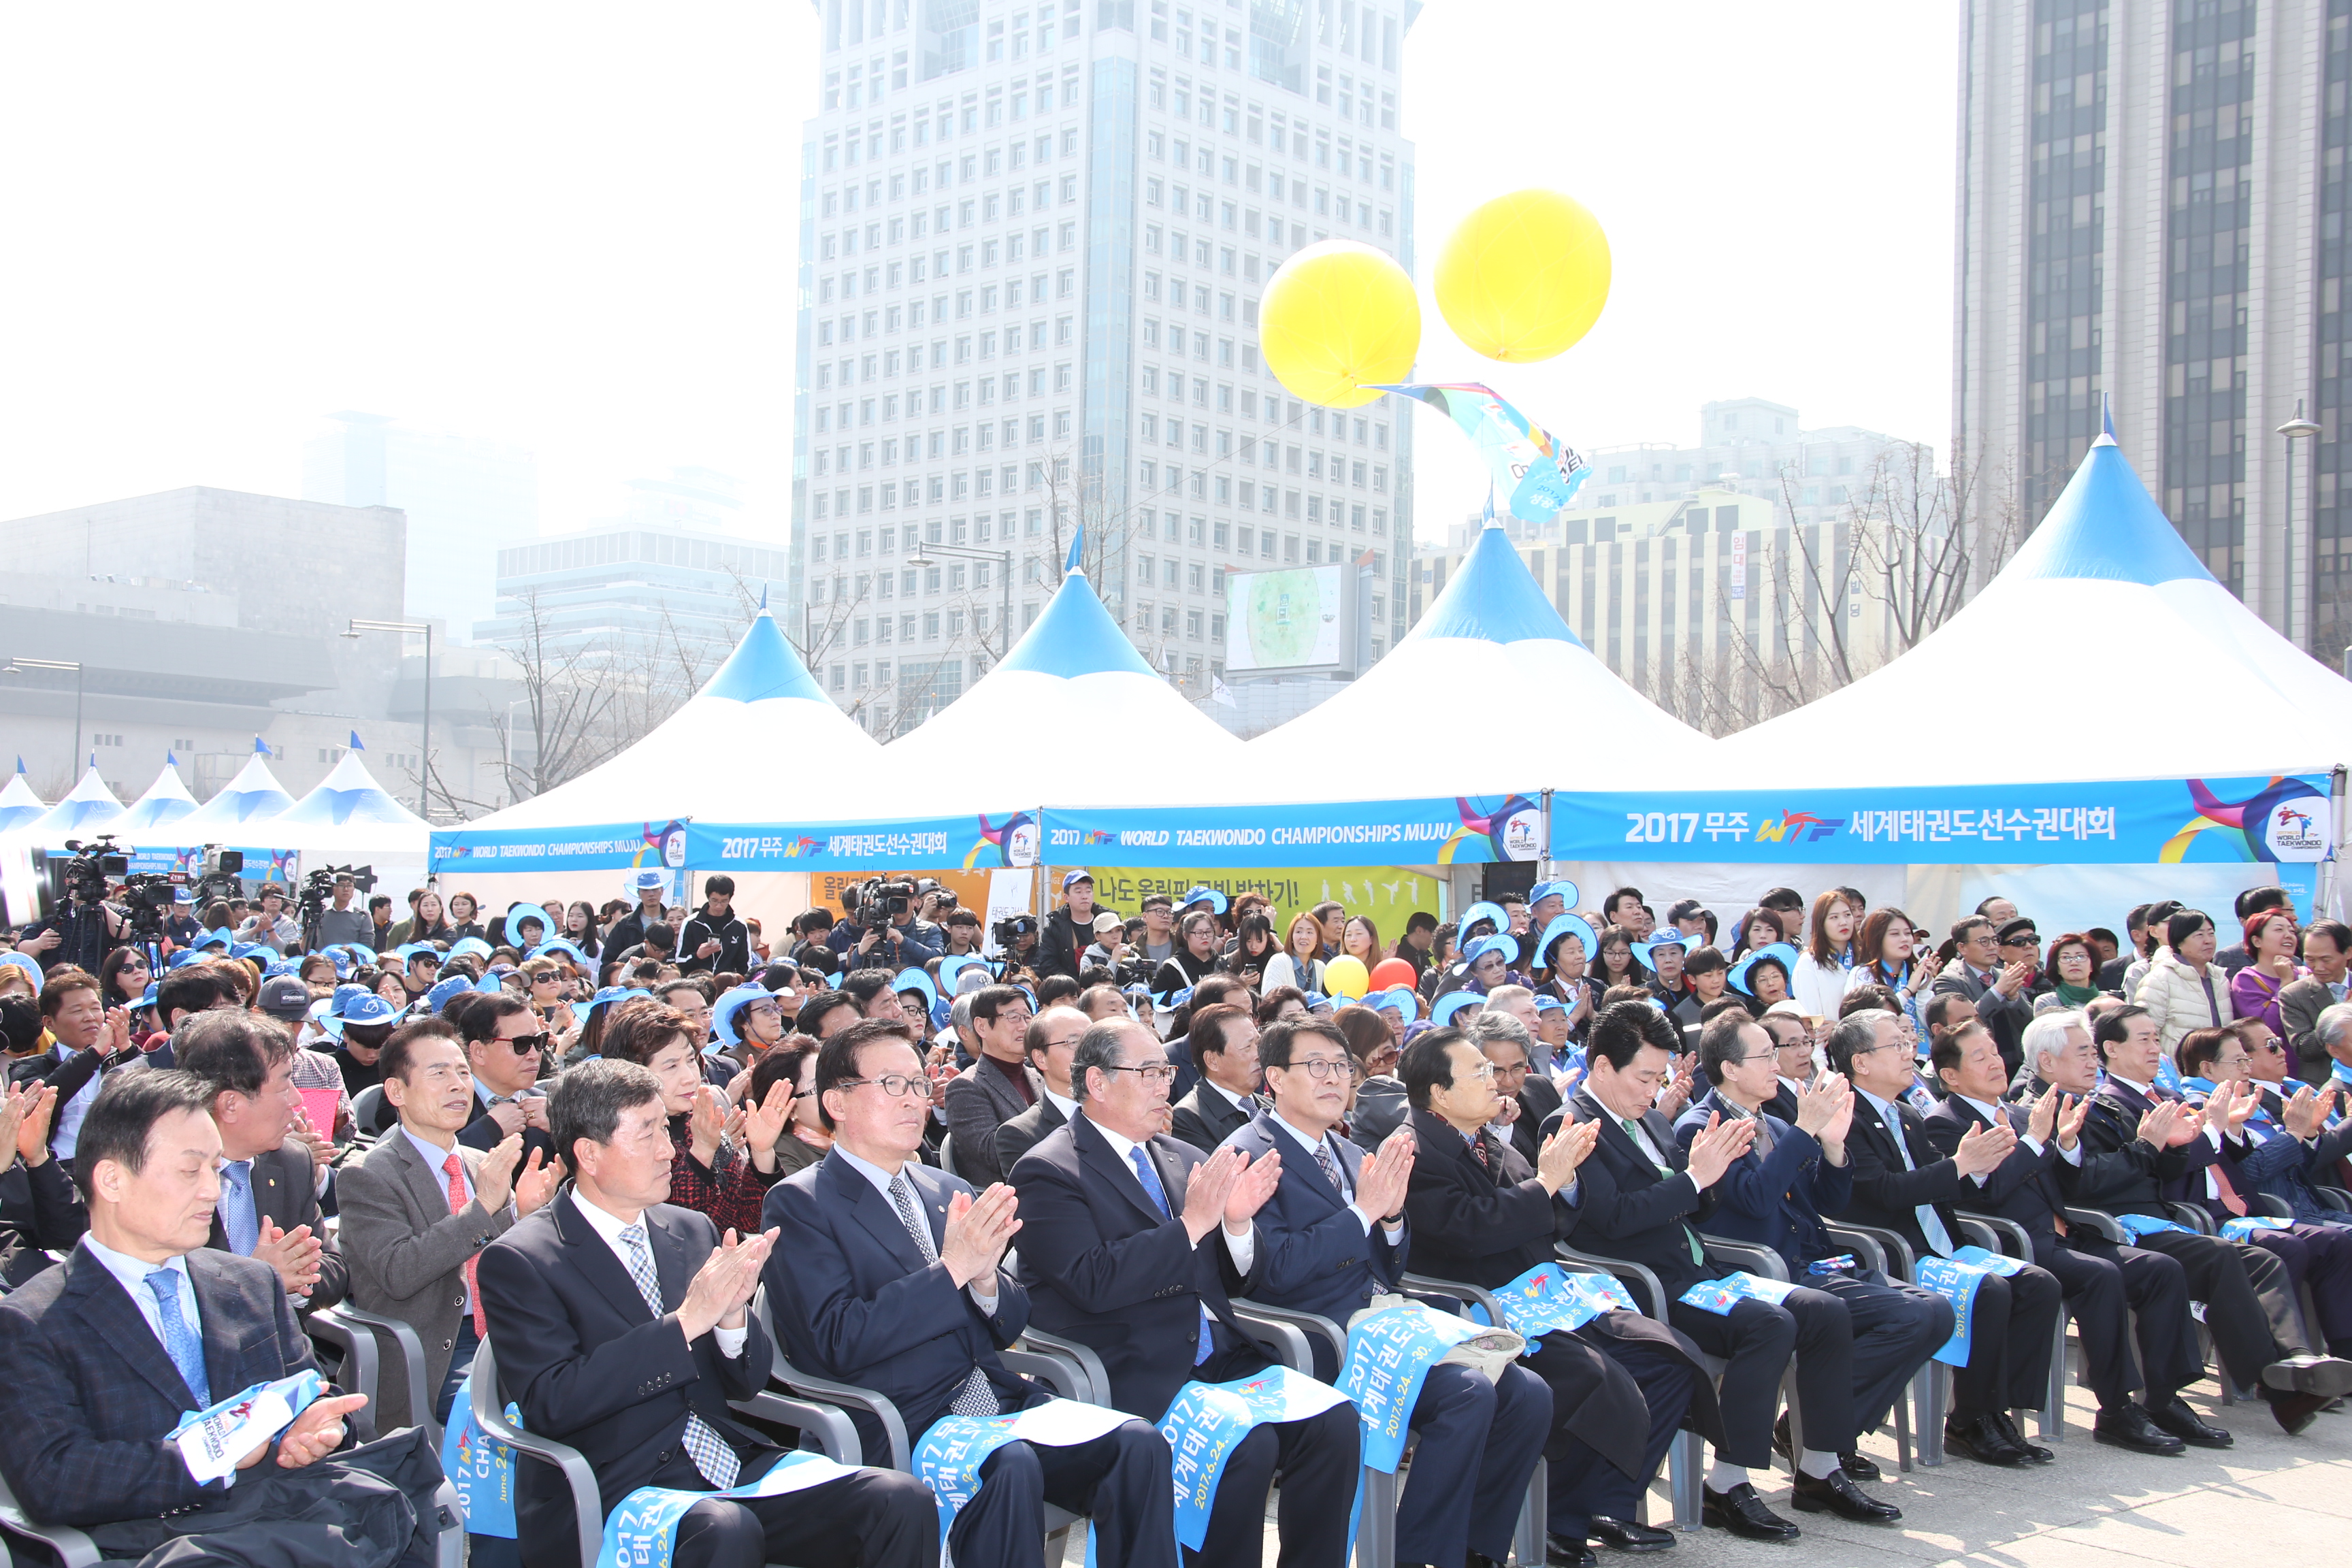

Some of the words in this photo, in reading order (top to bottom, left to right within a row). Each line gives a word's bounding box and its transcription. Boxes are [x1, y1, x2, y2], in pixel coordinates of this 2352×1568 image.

[1733, 537, 1744, 566] 임대
[1051, 829, 1080, 845] 2017
[1083, 828, 1117, 847] WTF
[1120, 830, 1170, 847] WORLD
[1176, 828, 1266, 846] TAEKWONDO
[1271, 824, 1401, 845] CHAMPIONSHIPS
[1403, 822, 1452, 842] MUJU
[1626, 812, 1699, 843] 2017
[1703, 812, 1750, 842] 무주
[1754, 808, 1846, 847] WTF
[1848, 806, 2116, 842] 세계태권도선수권대회
[152, 853, 176, 861] TAEKWONDO
[434, 846, 452, 858] 2017
[473, 845, 497, 858] WORLD
[500, 843, 546, 858] TAEKWONDO
[547, 840, 614, 857] CHAMPIONSHIPS
[614, 838, 641, 852] MUJU
[721, 838, 759, 859] 2017
[760, 836, 783, 857] 무주
[783, 834, 827, 860] WTF
[828, 832, 947, 858] 세계태권도선수권대회
[1099, 877, 1136, 904] 나도
[992, 906, 1011, 917] 태권도
[1348, 1337, 1376, 1394] 2017
[1362, 1316, 1402, 1338] 무주
[1162, 1398, 1194, 1452] 017
[458, 1467, 472, 1519] 2017
[616, 1509, 638, 1568] 017
